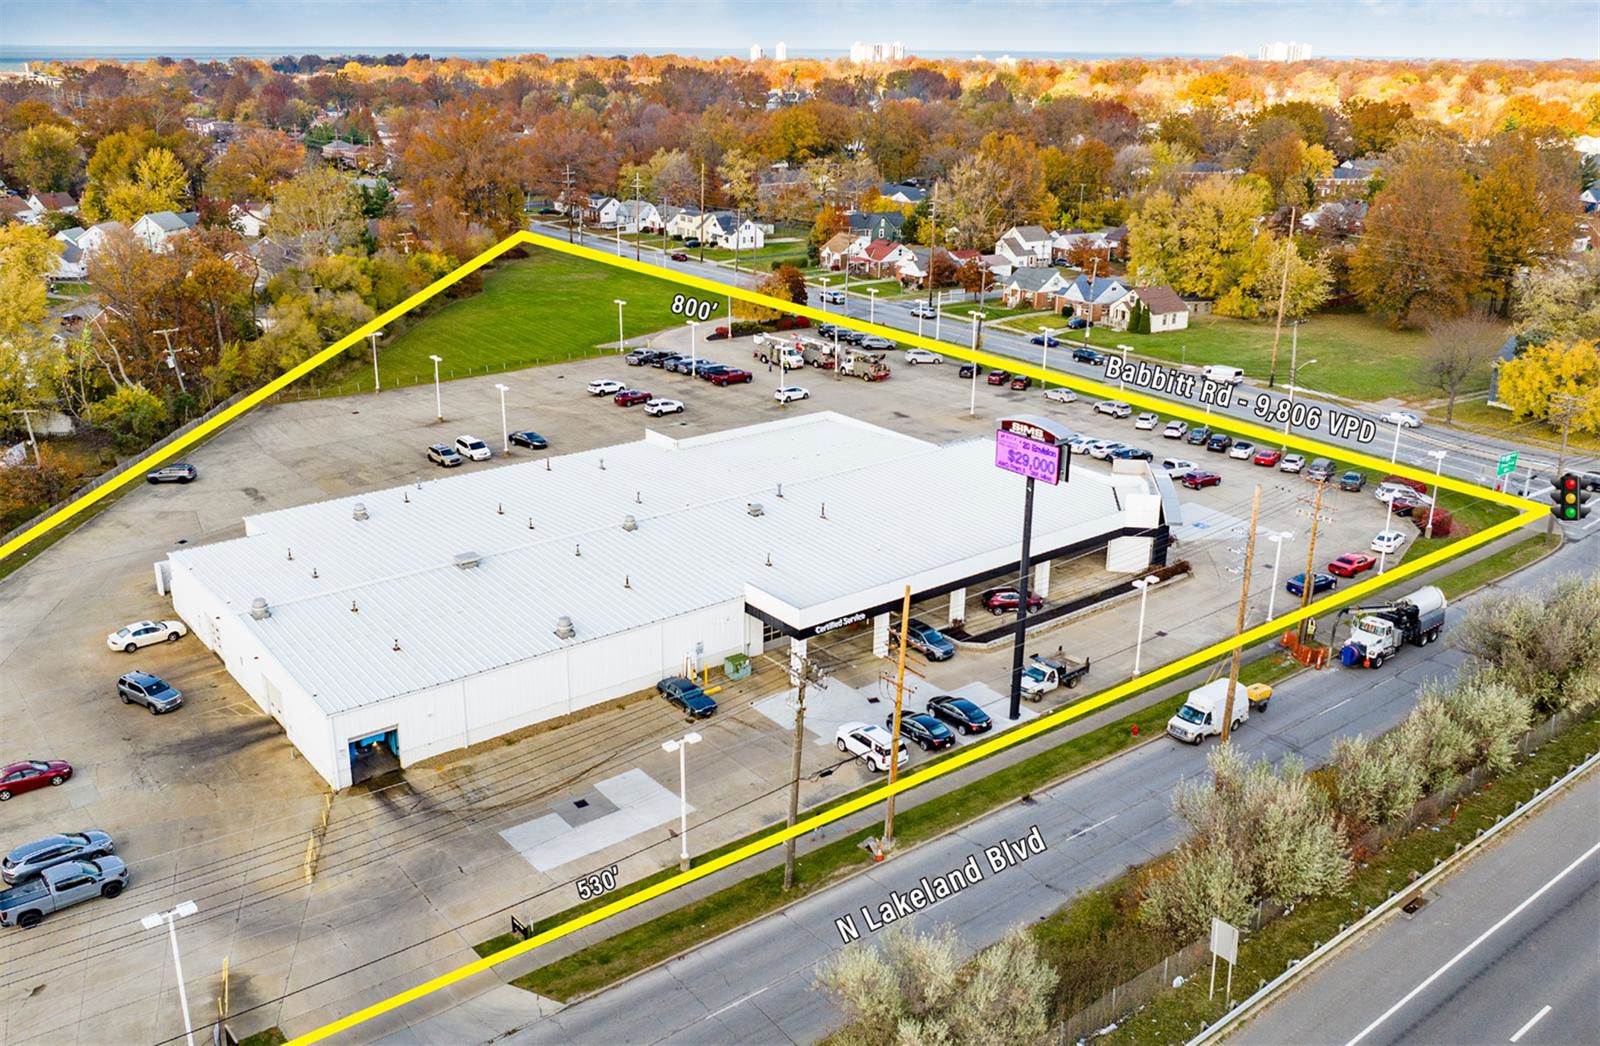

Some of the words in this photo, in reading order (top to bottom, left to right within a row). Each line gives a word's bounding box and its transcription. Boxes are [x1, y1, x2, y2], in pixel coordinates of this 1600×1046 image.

[1012, 423, 1043, 437] SIMS
[1008, 449, 1055, 475] $29,000
[815, 618, 843, 634] Certified
[843, 612, 866, 626] Service
